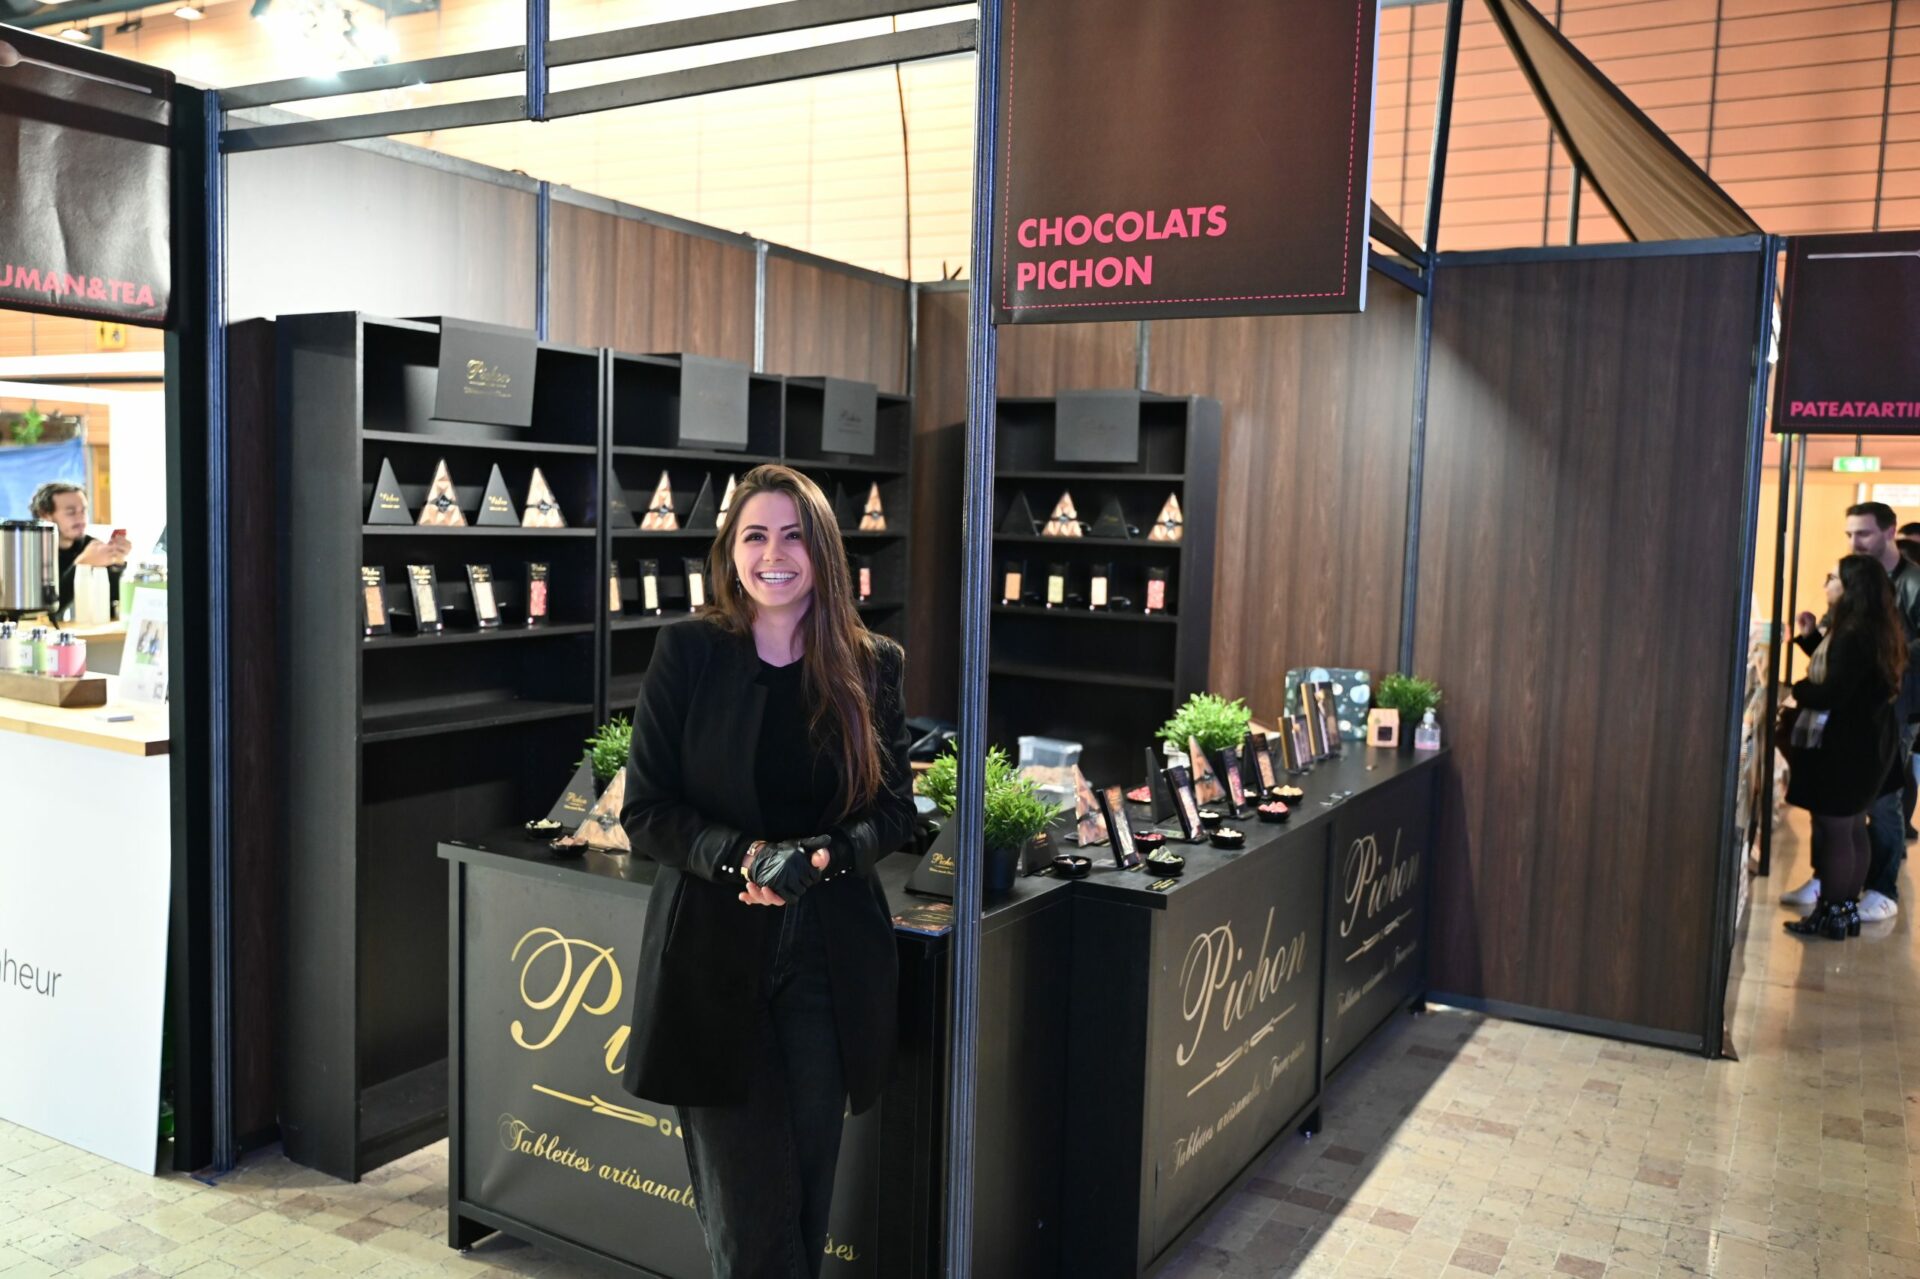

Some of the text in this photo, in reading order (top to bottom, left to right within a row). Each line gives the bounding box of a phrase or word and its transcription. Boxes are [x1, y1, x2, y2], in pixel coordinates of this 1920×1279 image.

[1017, 204, 1228, 248] CHOCOLATS
[1016, 255, 1153, 291] PICHON
[1340, 826, 1420, 938] Pichon
[0, 947, 62, 998] heur
[1176, 905, 1306, 1068] Pichon
[498, 1112, 697, 1209] Tablettes artisanal
